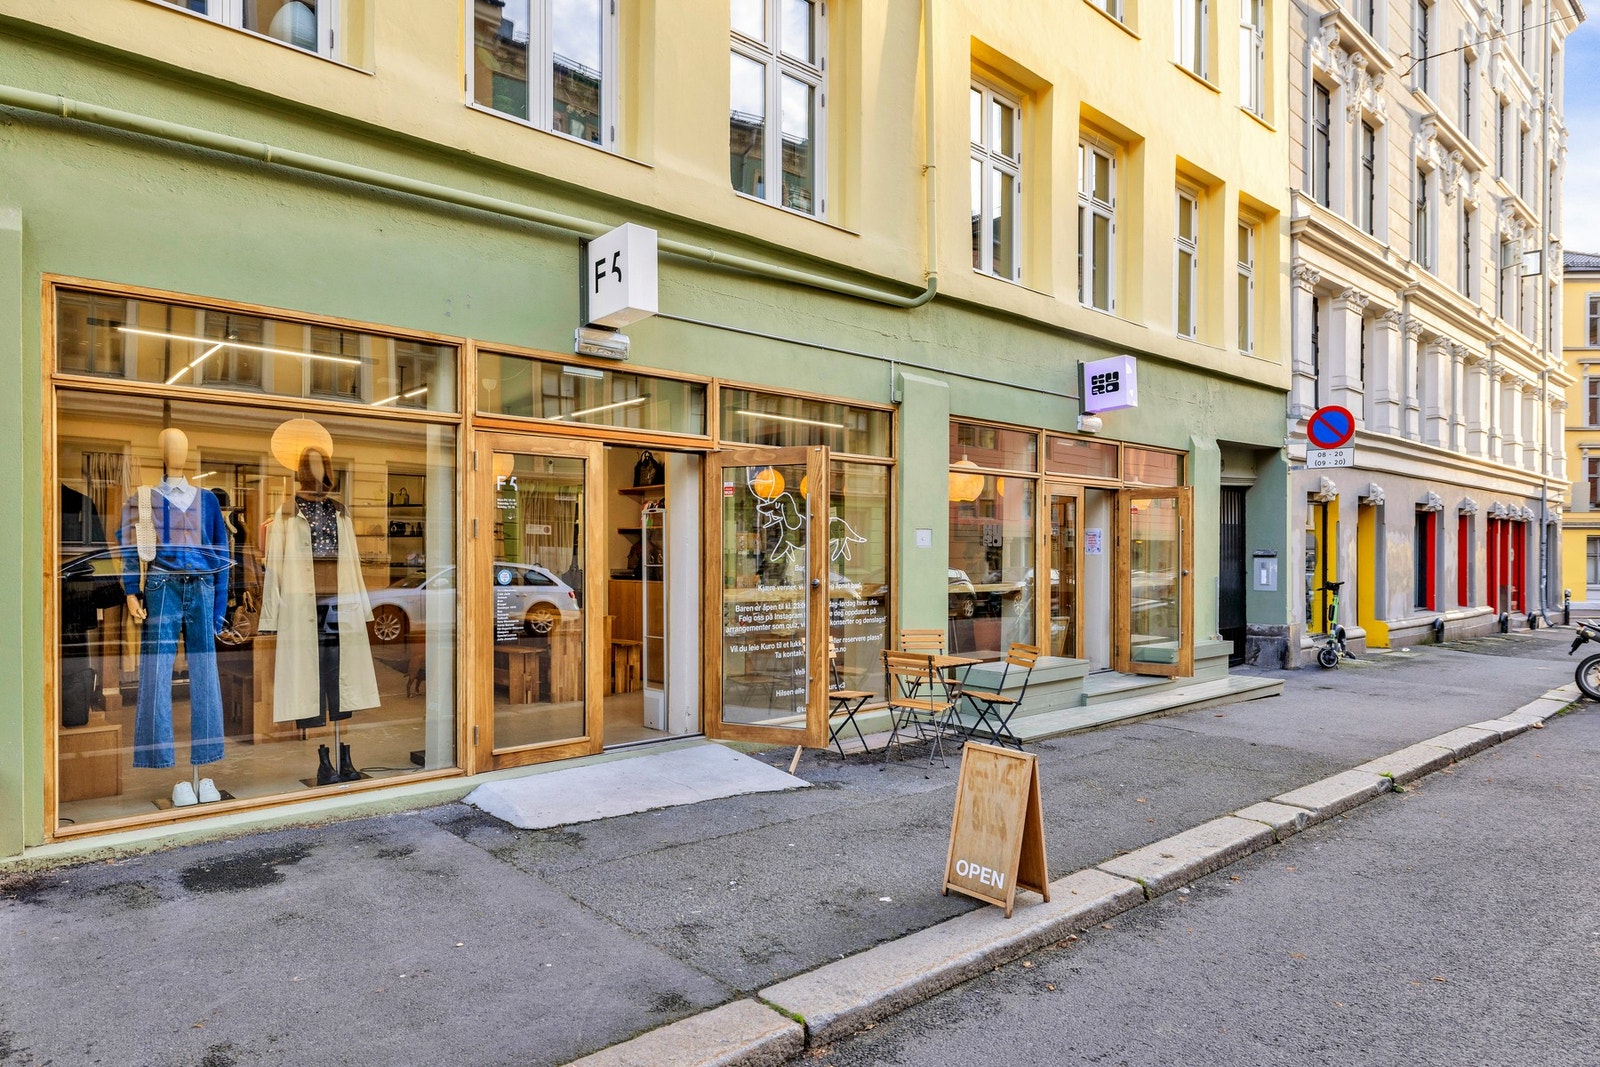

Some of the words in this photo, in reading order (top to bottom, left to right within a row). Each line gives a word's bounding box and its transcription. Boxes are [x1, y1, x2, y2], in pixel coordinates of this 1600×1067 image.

[762, 604, 777, 612] åpen
[774, 613, 803, 621] Instagram
[845, 608, 869, 616] oppdatert
[726, 624, 771, 633] arrangementer
[956, 859, 1004, 890] OPEN
